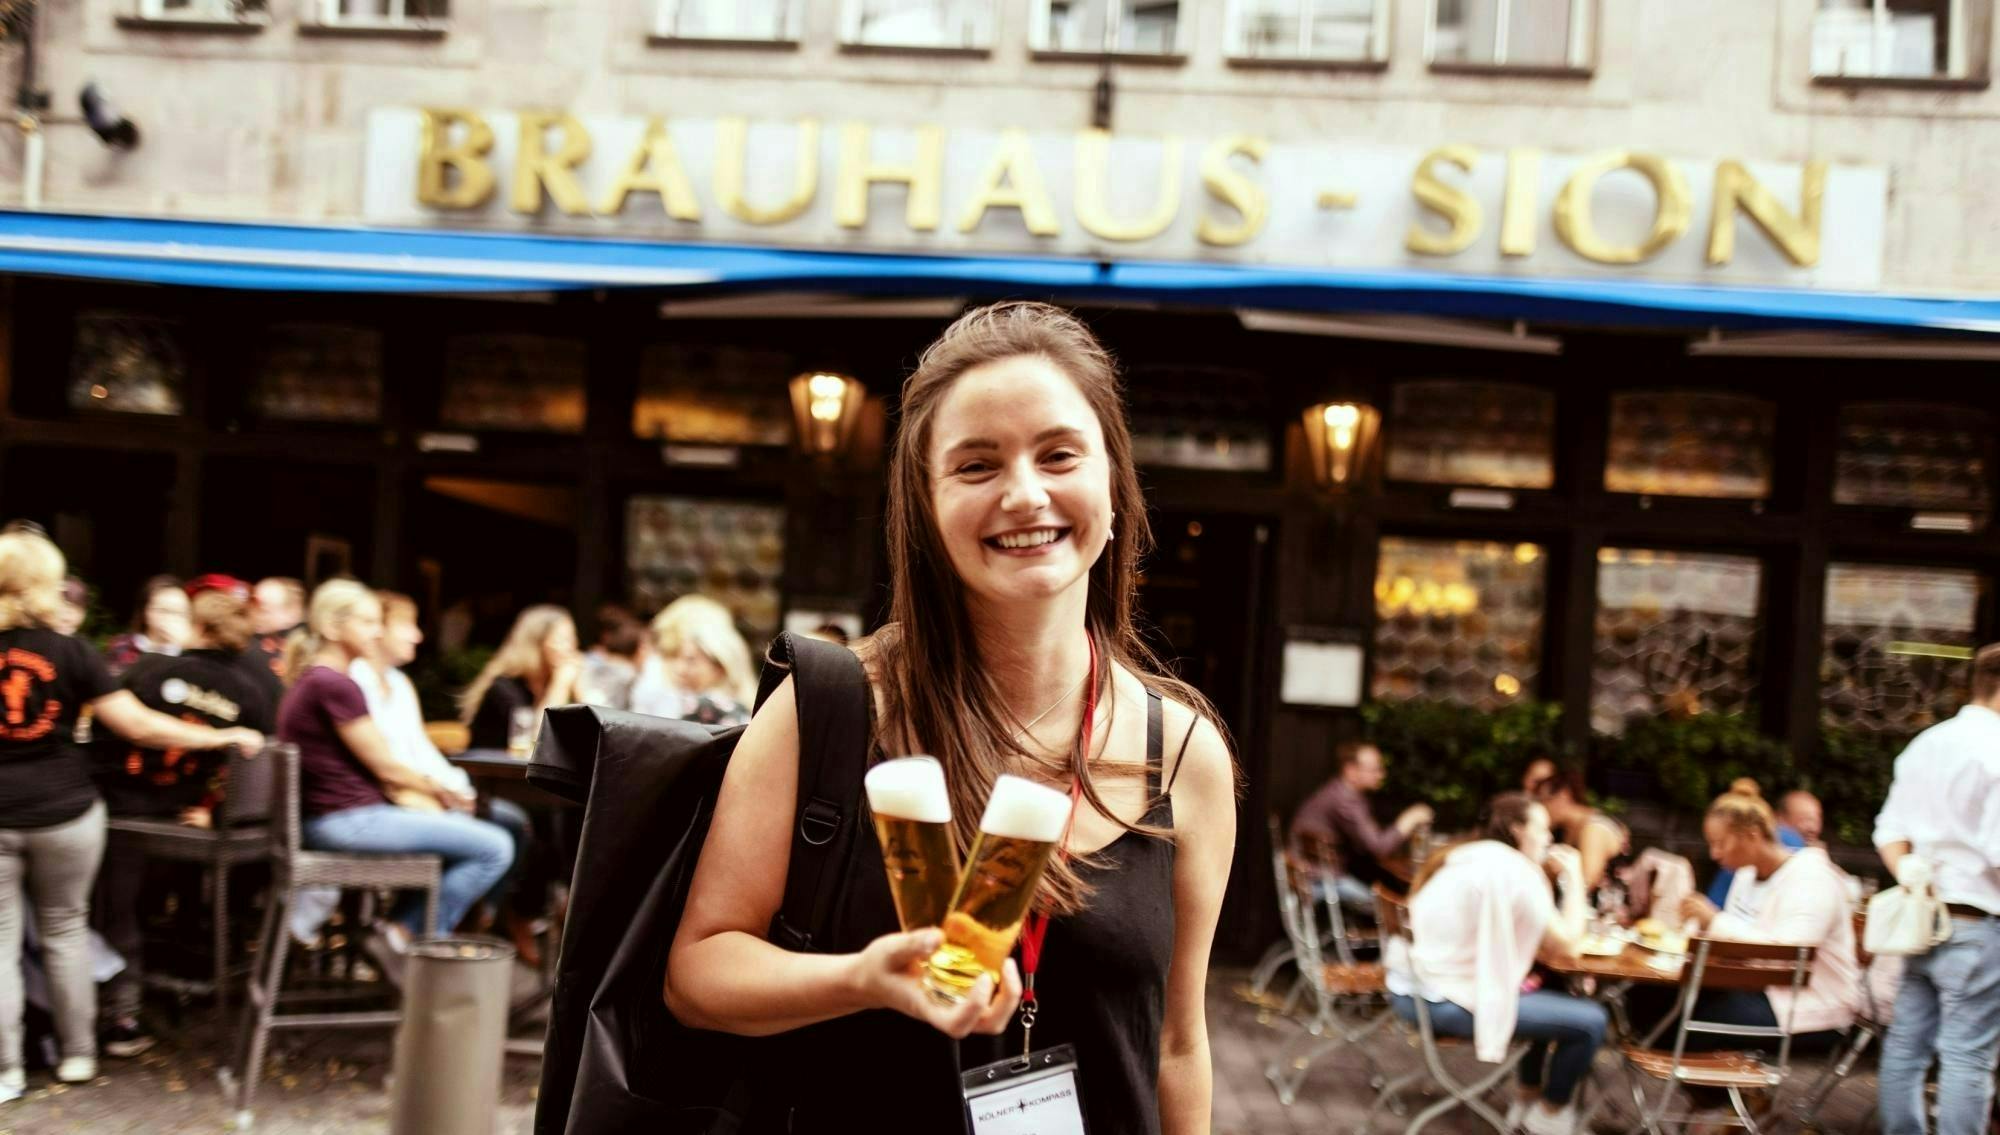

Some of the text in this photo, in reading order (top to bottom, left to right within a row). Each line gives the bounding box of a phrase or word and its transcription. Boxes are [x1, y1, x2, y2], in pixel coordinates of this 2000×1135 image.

[417, 106, 1270, 249] BRAUHAUS
[1404, 143, 1829, 268] SION
[978, 1089, 1072, 1122] KÖLNER KOMPASS
